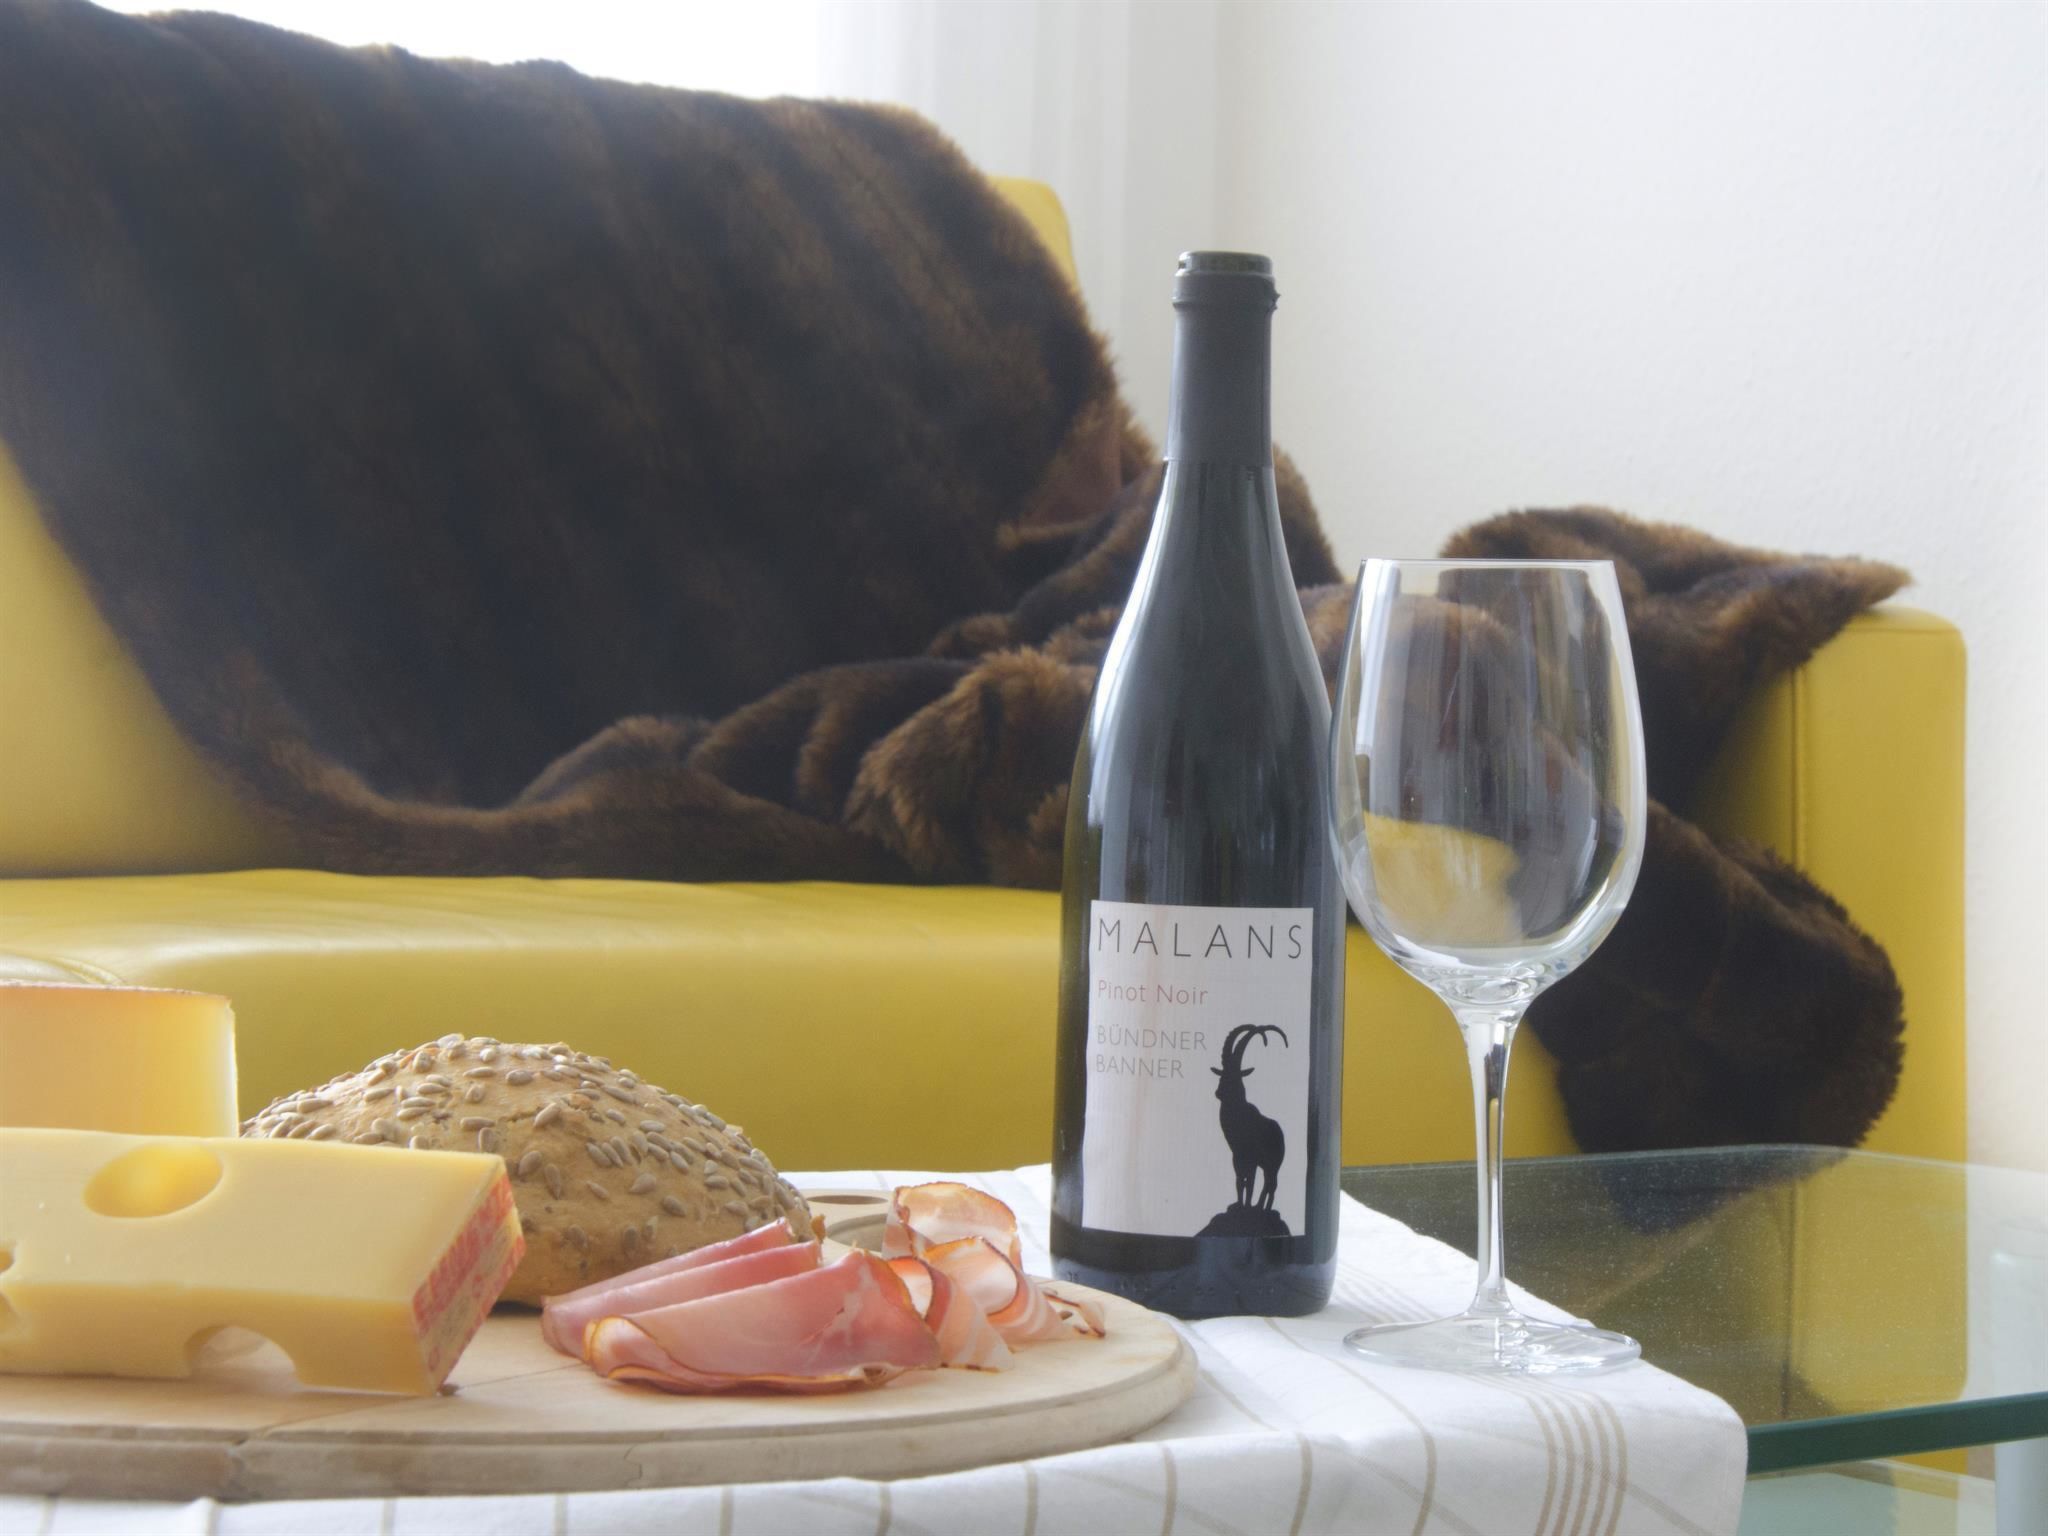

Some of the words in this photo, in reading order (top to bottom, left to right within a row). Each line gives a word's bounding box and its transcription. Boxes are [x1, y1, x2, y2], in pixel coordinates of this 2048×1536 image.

[1098, 918, 1302, 959] MALANS
[1098, 979, 1146, 1002] Pinot
[1155, 984, 1208, 1005] Noir
[1096, 1023, 1208, 1051] BÜNDNER
[1095, 1053, 1185, 1079] BANNER
